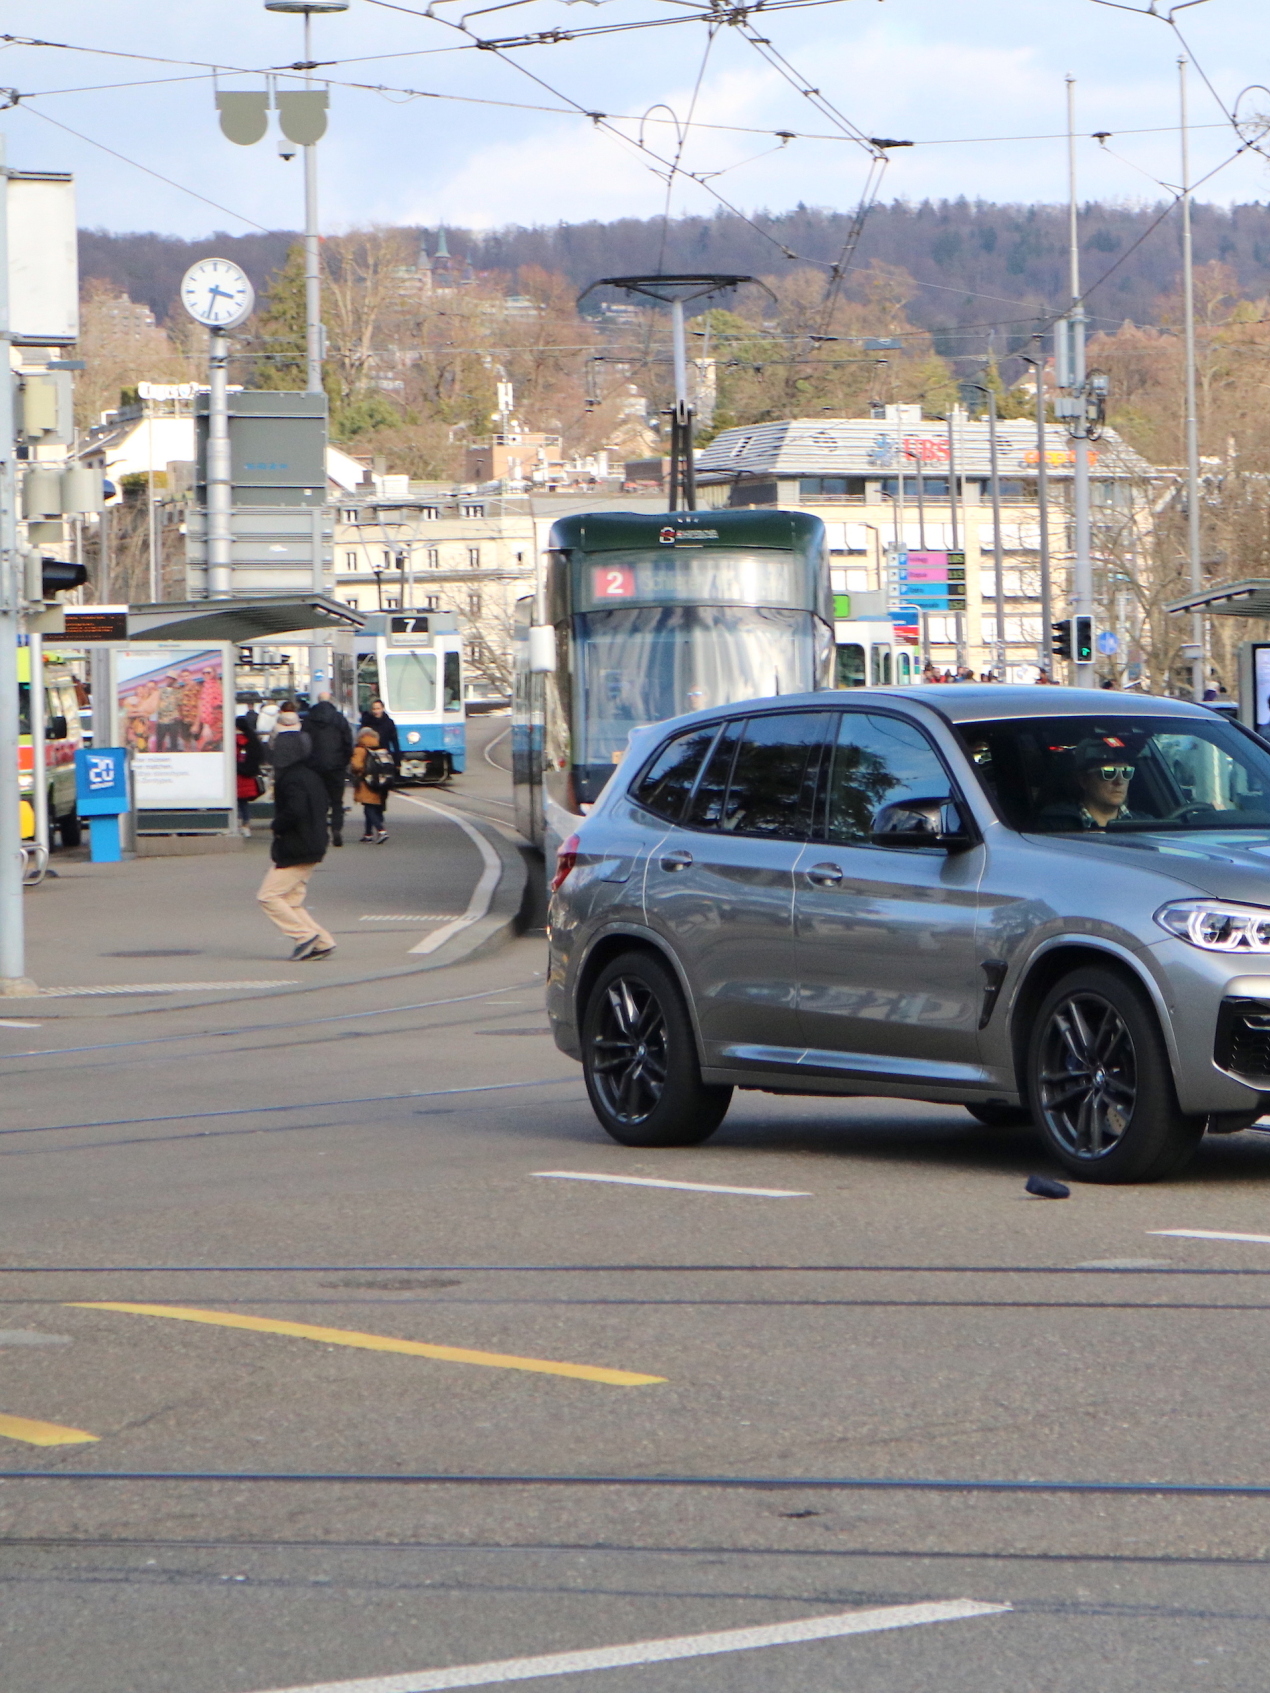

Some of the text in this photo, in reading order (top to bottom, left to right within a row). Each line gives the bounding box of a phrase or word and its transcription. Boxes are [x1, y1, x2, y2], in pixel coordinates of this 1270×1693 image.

[903, 438, 949, 461] UBS
[606, 571, 624, 594] 2
[403, 619, 416, 633] 7
